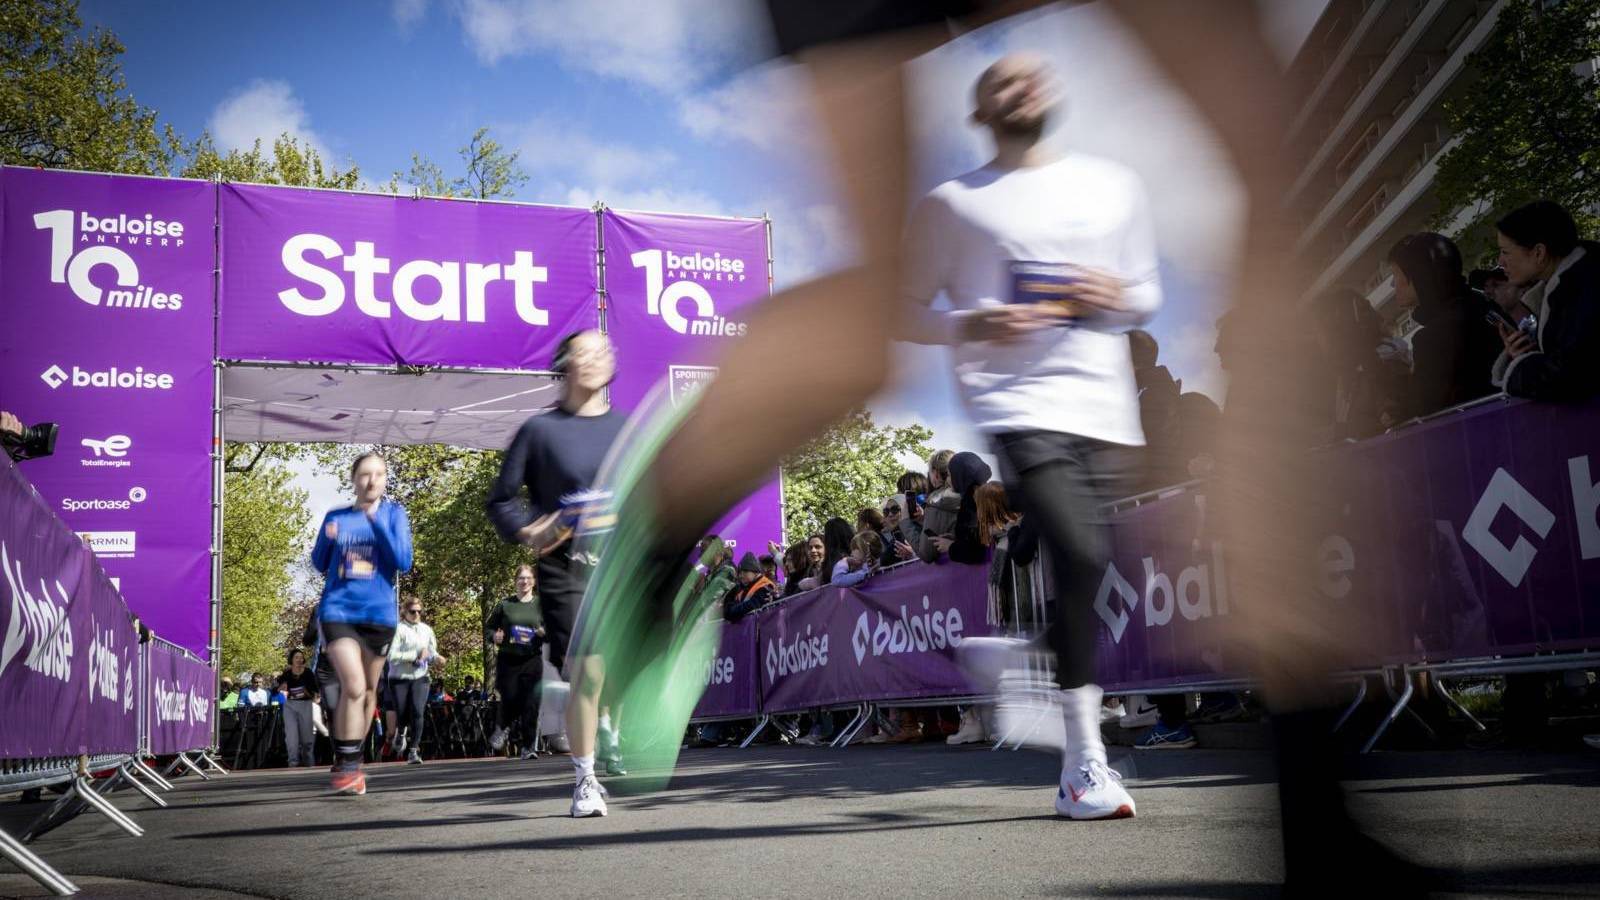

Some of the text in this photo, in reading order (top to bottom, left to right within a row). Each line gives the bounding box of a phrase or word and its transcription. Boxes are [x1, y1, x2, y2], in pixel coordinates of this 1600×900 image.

[81, 212, 184, 236] baloise
[81, 234, 184, 247] ANTWERP
[33, 210, 139, 306] 10
[666, 251, 745, 273] baloise
[278, 233, 549, 326] Start
[667, 270, 745, 282] ANTWERP
[106, 285, 183, 310] miles
[631, 249, 714, 334] 10
[691, 315, 748, 336] miles
[72, 366, 174, 389] baloise
[62, 498, 131, 511] Sportoase
[1142, 534, 1355, 627] bale
[873, 595, 964, 656] baloise
[778, 623, 829, 676] baloise
